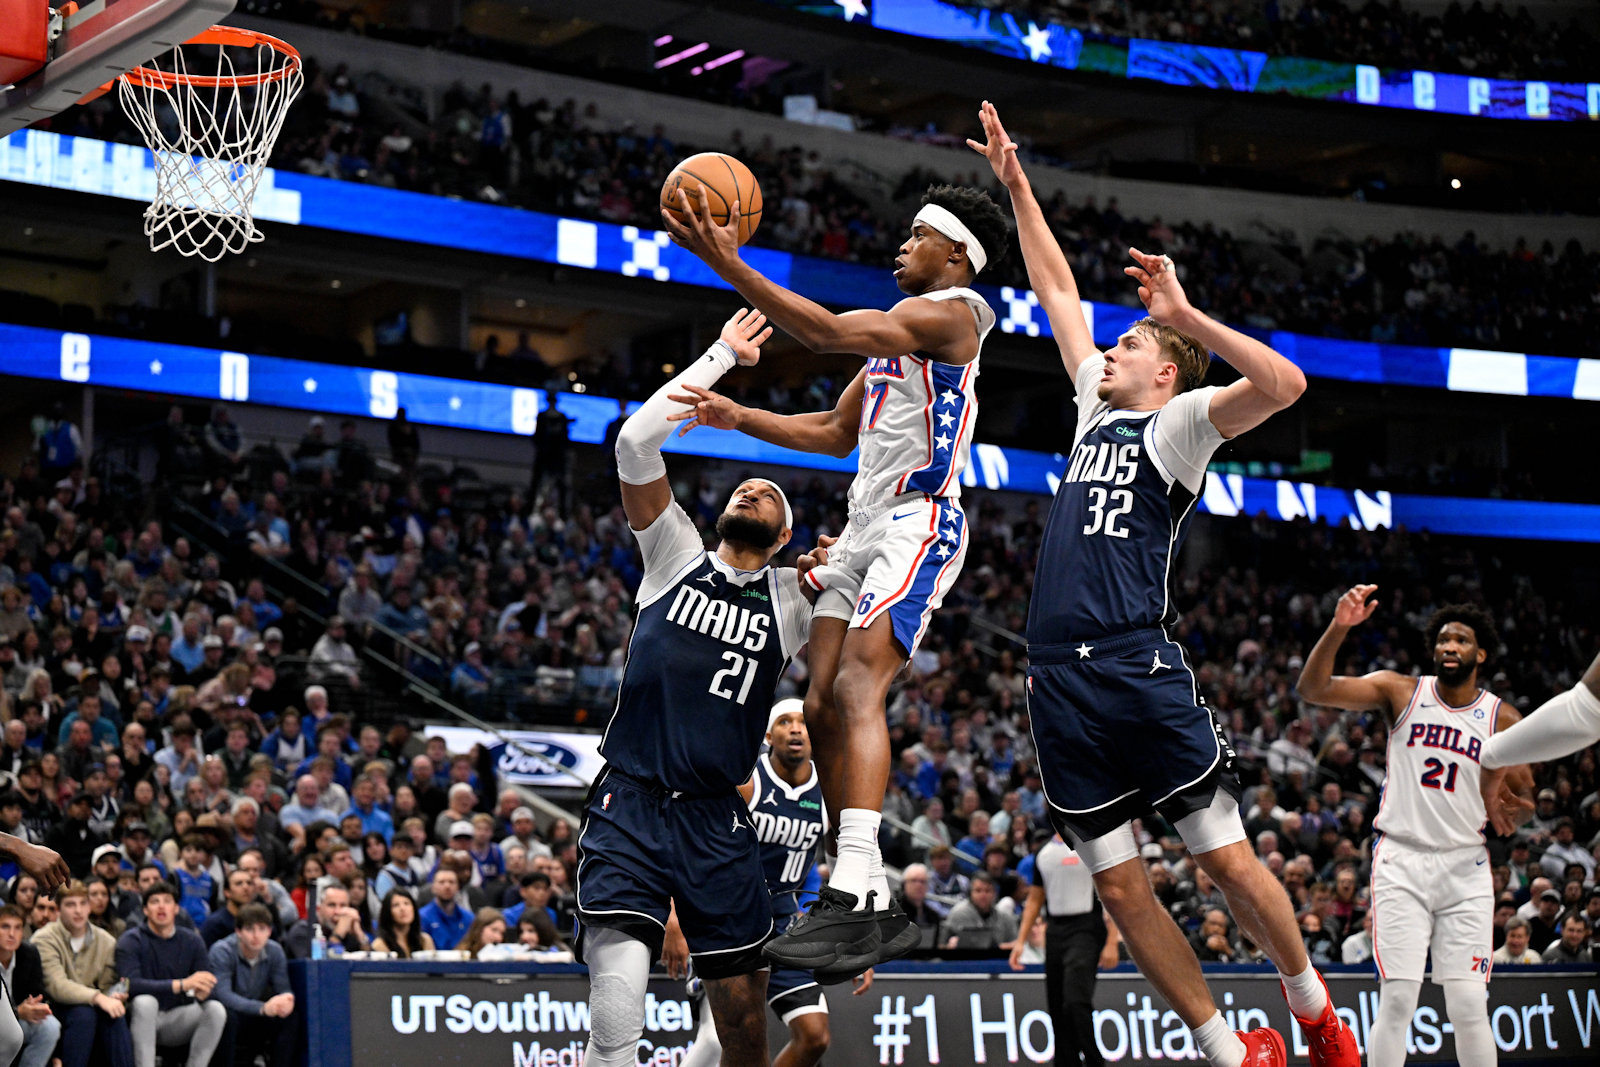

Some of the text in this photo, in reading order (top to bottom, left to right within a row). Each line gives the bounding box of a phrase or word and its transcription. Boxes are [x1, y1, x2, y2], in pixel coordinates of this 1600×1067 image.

[1083, 487, 1134, 539] 32
[741, 588, 769, 602] chime
[665, 583, 771, 652] MAVS
[708, 650, 759, 706] 21
[498, 740, 565, 775] Ford
[1406, 723, 1482, 765] PHILA
[1420, 757, 1459, 793] 21
[751, 810, 823, 851] MAVS
[779, 850, 808, 883] 10
[1471, 955, 1489, 974] 76
[873, 994, 941, 1065] #1
